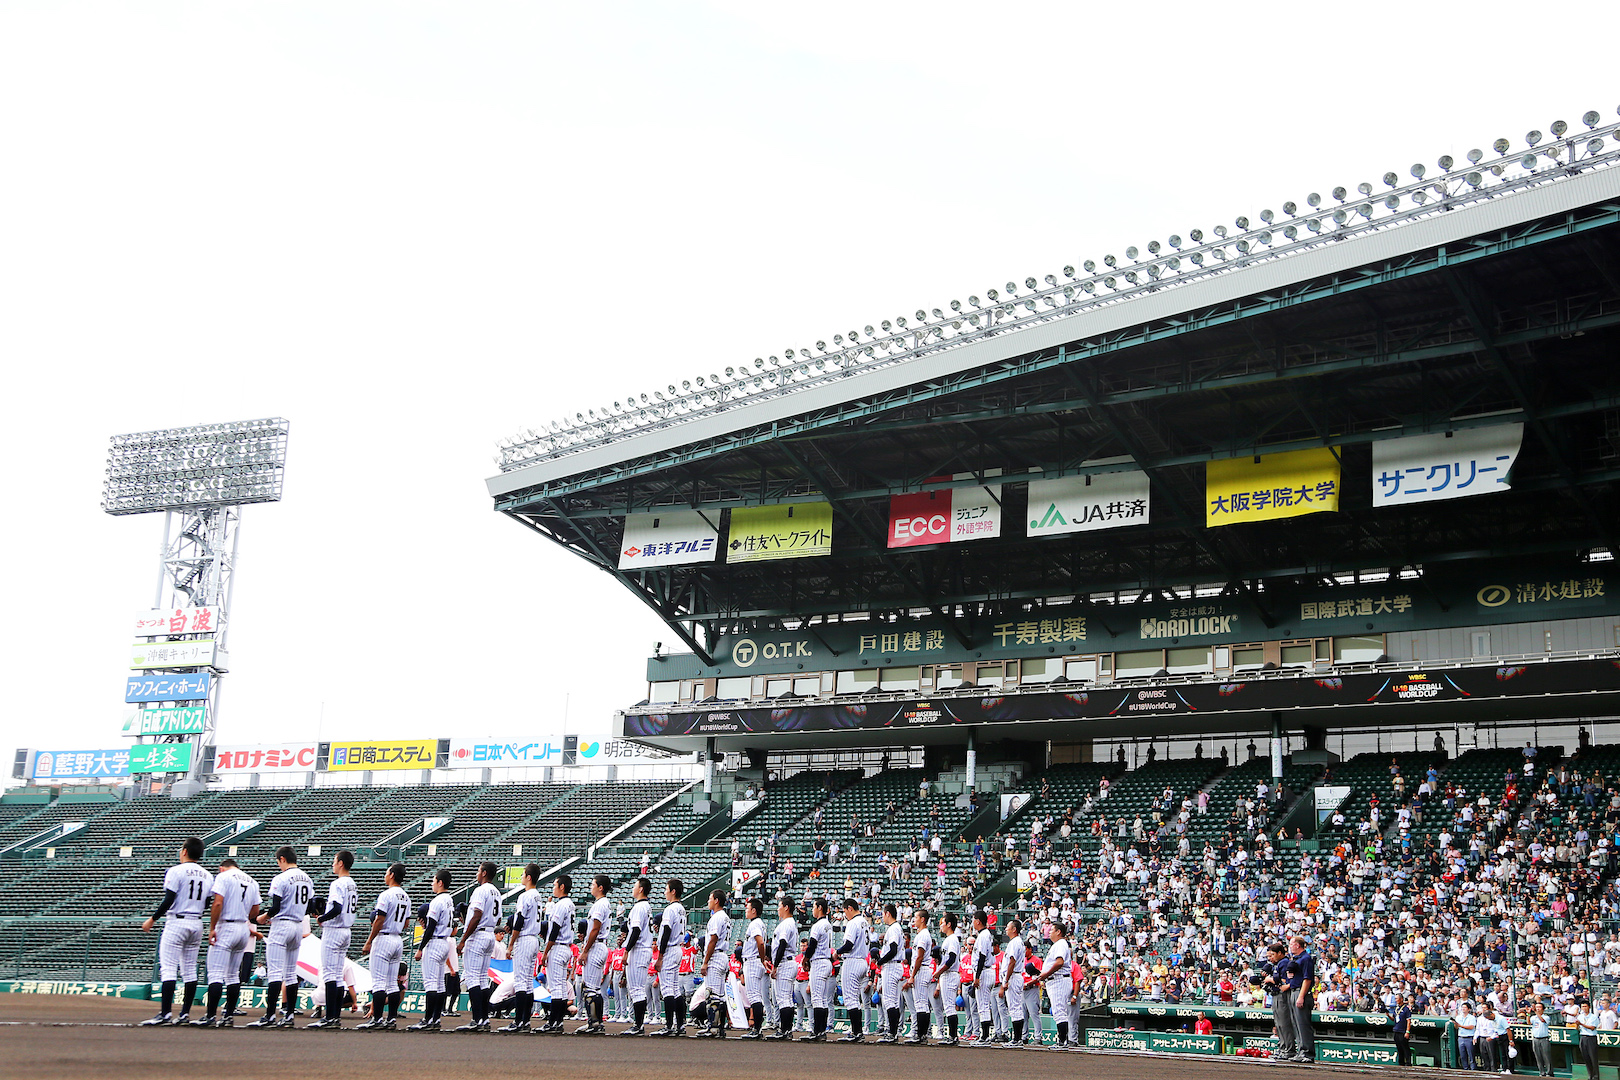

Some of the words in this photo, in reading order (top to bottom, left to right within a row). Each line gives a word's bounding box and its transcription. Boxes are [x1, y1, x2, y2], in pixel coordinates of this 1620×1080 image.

[1211, 480, 1336, 516] 大阪学院大学
[957, 505, 989, 520] ジュニア
[1073, 498, 1147, 525] JA共済
[894, 514, 946, 539] ECC
[957, 520, 993, 535] 外語学院
[642, 538, 715, 557] 東洋アルミ
[743, 529, 830, 551] 住友ベークライト
[1516, 578, 1605, 603] 清水建設
[1301, 595, 1412, 620] 国際武道大学
[993, 616, 1087, 647] 千寿製薬
[762, 641, 812, 659] O.T.K.
[858, 629, 945, 655] 戸田建設
[1138, 690, 1167, 700] @WBSC
[1408, 683, 1443, 691] BASEBALL
[1129, 702, 1176, 710] #U18WorldCup
[216, 747, 315, 769] オロナミンC
[348, 745, 432, 765] 日商エステム
[473, 743, 561, 761] 日本ペイント
[53, 751, 130, 775] 藍野大学
[189, 880, 203, 900] 11
[241, 883, 248, 902] 7
[295, 885, 308, 904] 18
[346, 895, 357, 914] 19
[394, 903, 407, 922] 17
[1320, 1015, 1338, 1023] UCC
[1246, 1039, 1270, 1048] SOMPO
